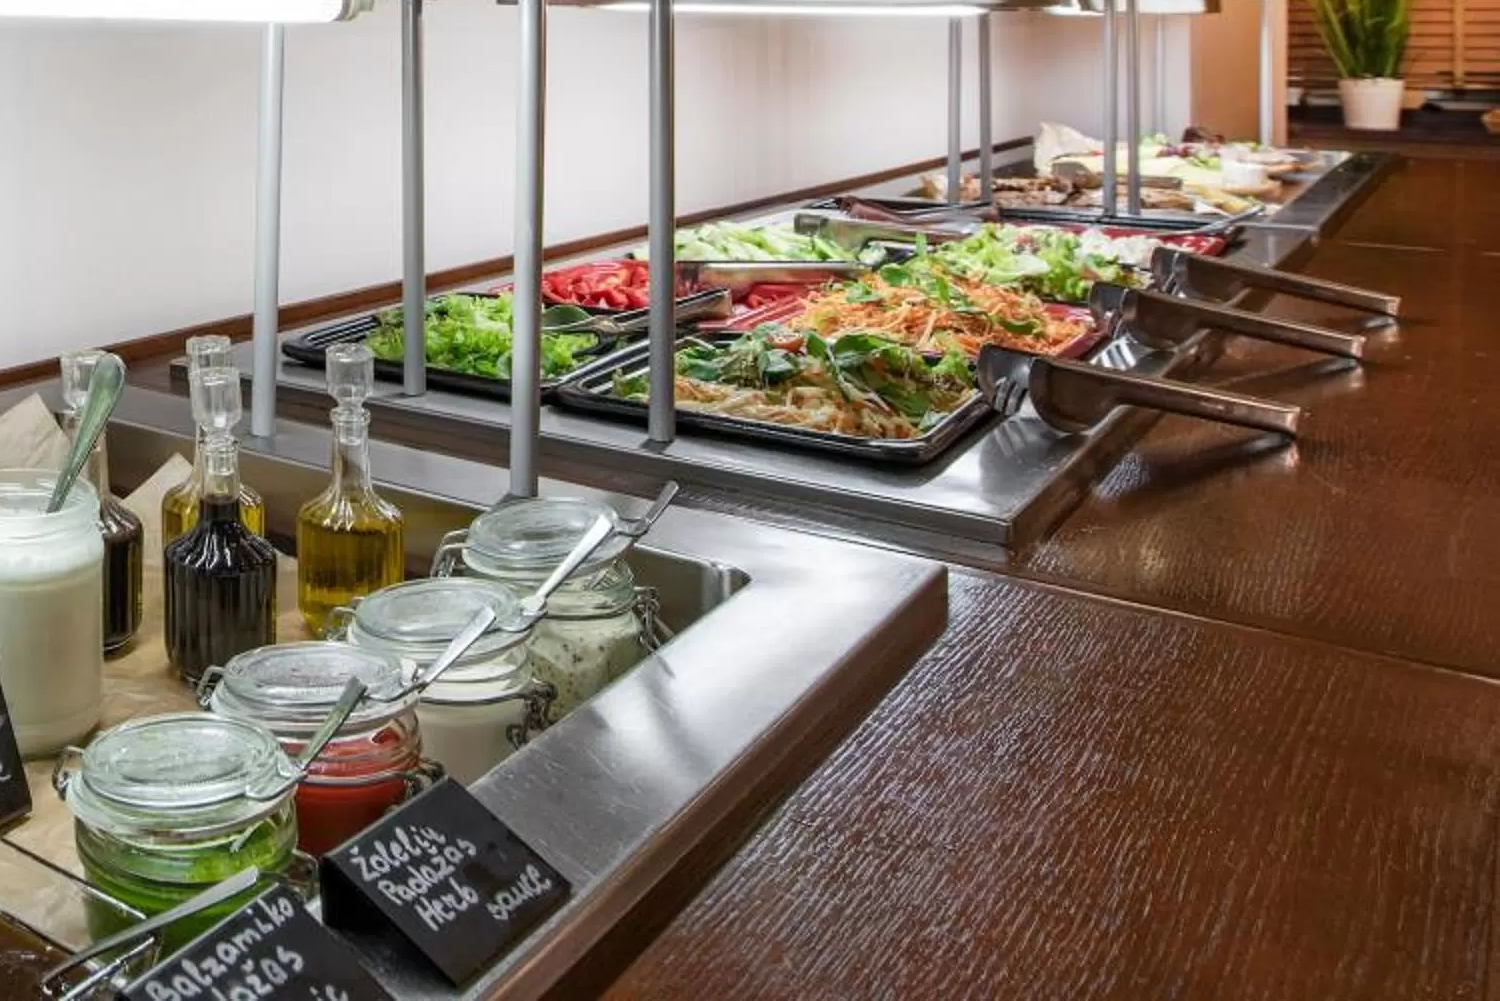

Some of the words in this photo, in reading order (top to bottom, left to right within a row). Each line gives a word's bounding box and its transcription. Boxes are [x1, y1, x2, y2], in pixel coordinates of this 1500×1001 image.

[414, 877, 479, 932] Herb
[486, 864, 551, 920] sauce
[145, 897, 295, 1001] Balzamiko
